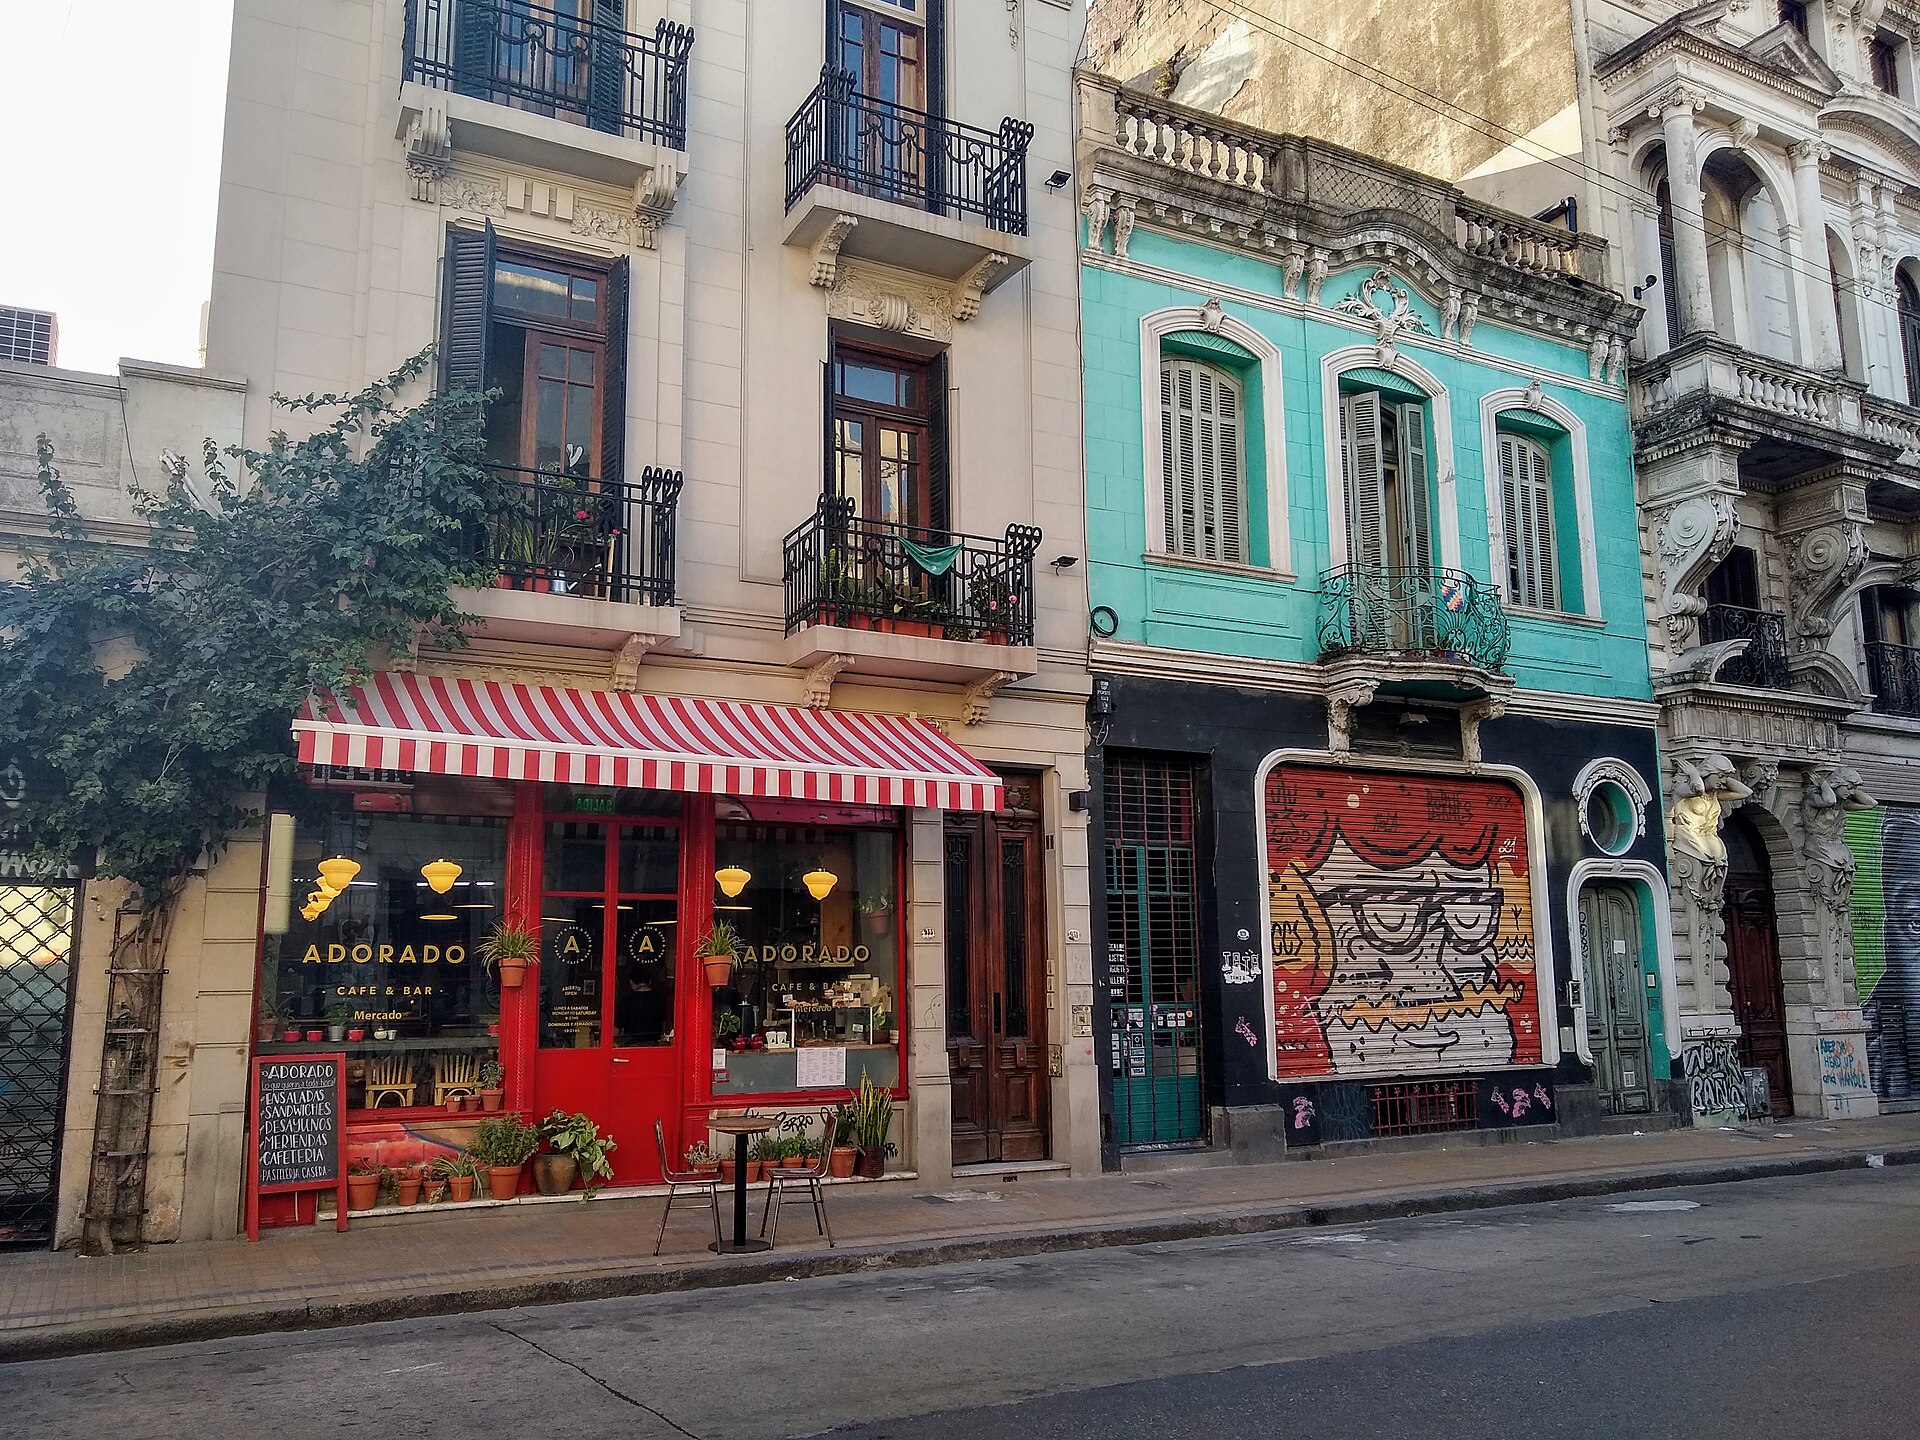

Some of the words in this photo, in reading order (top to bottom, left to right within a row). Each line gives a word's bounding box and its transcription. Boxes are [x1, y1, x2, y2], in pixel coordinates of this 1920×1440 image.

[563, 935, 580, 953] A
[638, 935, 655, 952] A
[302, 944, 466, 964] ADORADO
[743, 944, 871, 964] ADORADO
[336, 986, 377, 996] CAFE
[385, 986, 394, 996] &
[403, 986, 433, 996] BAR
[771, 982, 802, 992] CAFE
[809, 982, 817, 991] &
[354, 1010, 403, 1021] Mercado
[795, 1002, 833, 1014] Mercado
[267, 1065, 334, 1079] ADORADO
[265, 1089, 325, 1106] ENSALADAS
[265, 1101, 332, 1119] SANDWICHES
[265, 1117, 332, 1135] DESAYUNOS
[263, 1132, 328, 1150] MERIENDAS
[263, 1148, 324, 1166] CAFETERIA
